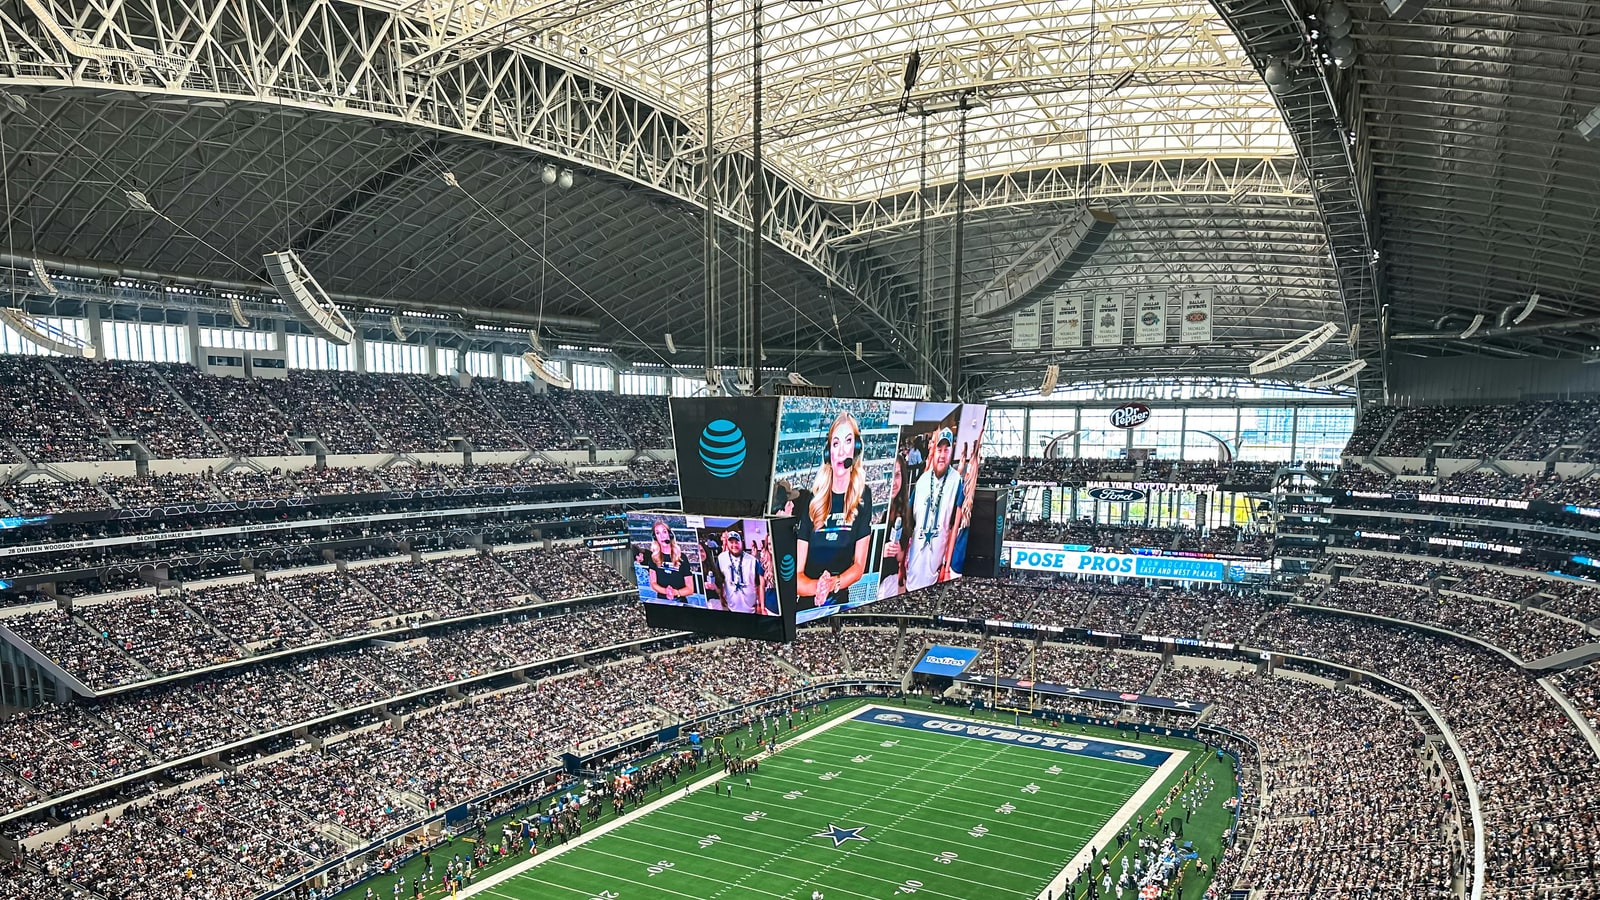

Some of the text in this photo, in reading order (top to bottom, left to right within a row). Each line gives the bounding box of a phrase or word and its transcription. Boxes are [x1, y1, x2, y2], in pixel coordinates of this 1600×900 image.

[873, 382, 928, 400] AT&T STADIUM
[1115, 408, 1148, 426] Pepper
[1125, 406, 1139, 417] Dr
[1134, 482, 1166, 490] CRYPTO
[1168, 483, 1188, 491] PLAY
[1100, 490, 1134, 500] Ford
[1418, 494, 1440, 502] MAKE
[1441, 494, 1460, 504] YOUR
[1460, 496, 1488, 506] CRYPTO
[1488, 498, 1506, 508] PLAY
[1507, 500, 1530, 510] TODAY
[1428, 537, 1448, 546] MAKE
[1448, 539, 1463, 547] YOUR
[1464, 541, 1488, 550] CRYPTO
[1488, 544, 1503, 552] PLAY
[1504, 546, 1522, 554] TODAY
[1015, 551, 1133, 573] POSE PROS
[1142, 560, 1158, 568] NOW
[1163, 561, 1200, 570] LOCATED
[1192, 570, 1217, 578] PLAZAS
[1175, 638, 1198, 646] CRYPTO
[922, 720, 1088, 750] COWBOYS
[742, 810, 768, 822] 50
[968, 826, 989, 838] 40
[698, 834, 722, 847] 40
[933, 852, 958, 864] 50
[646, 860, 675, 874] 30
[898, 880, 924, 894] 40
